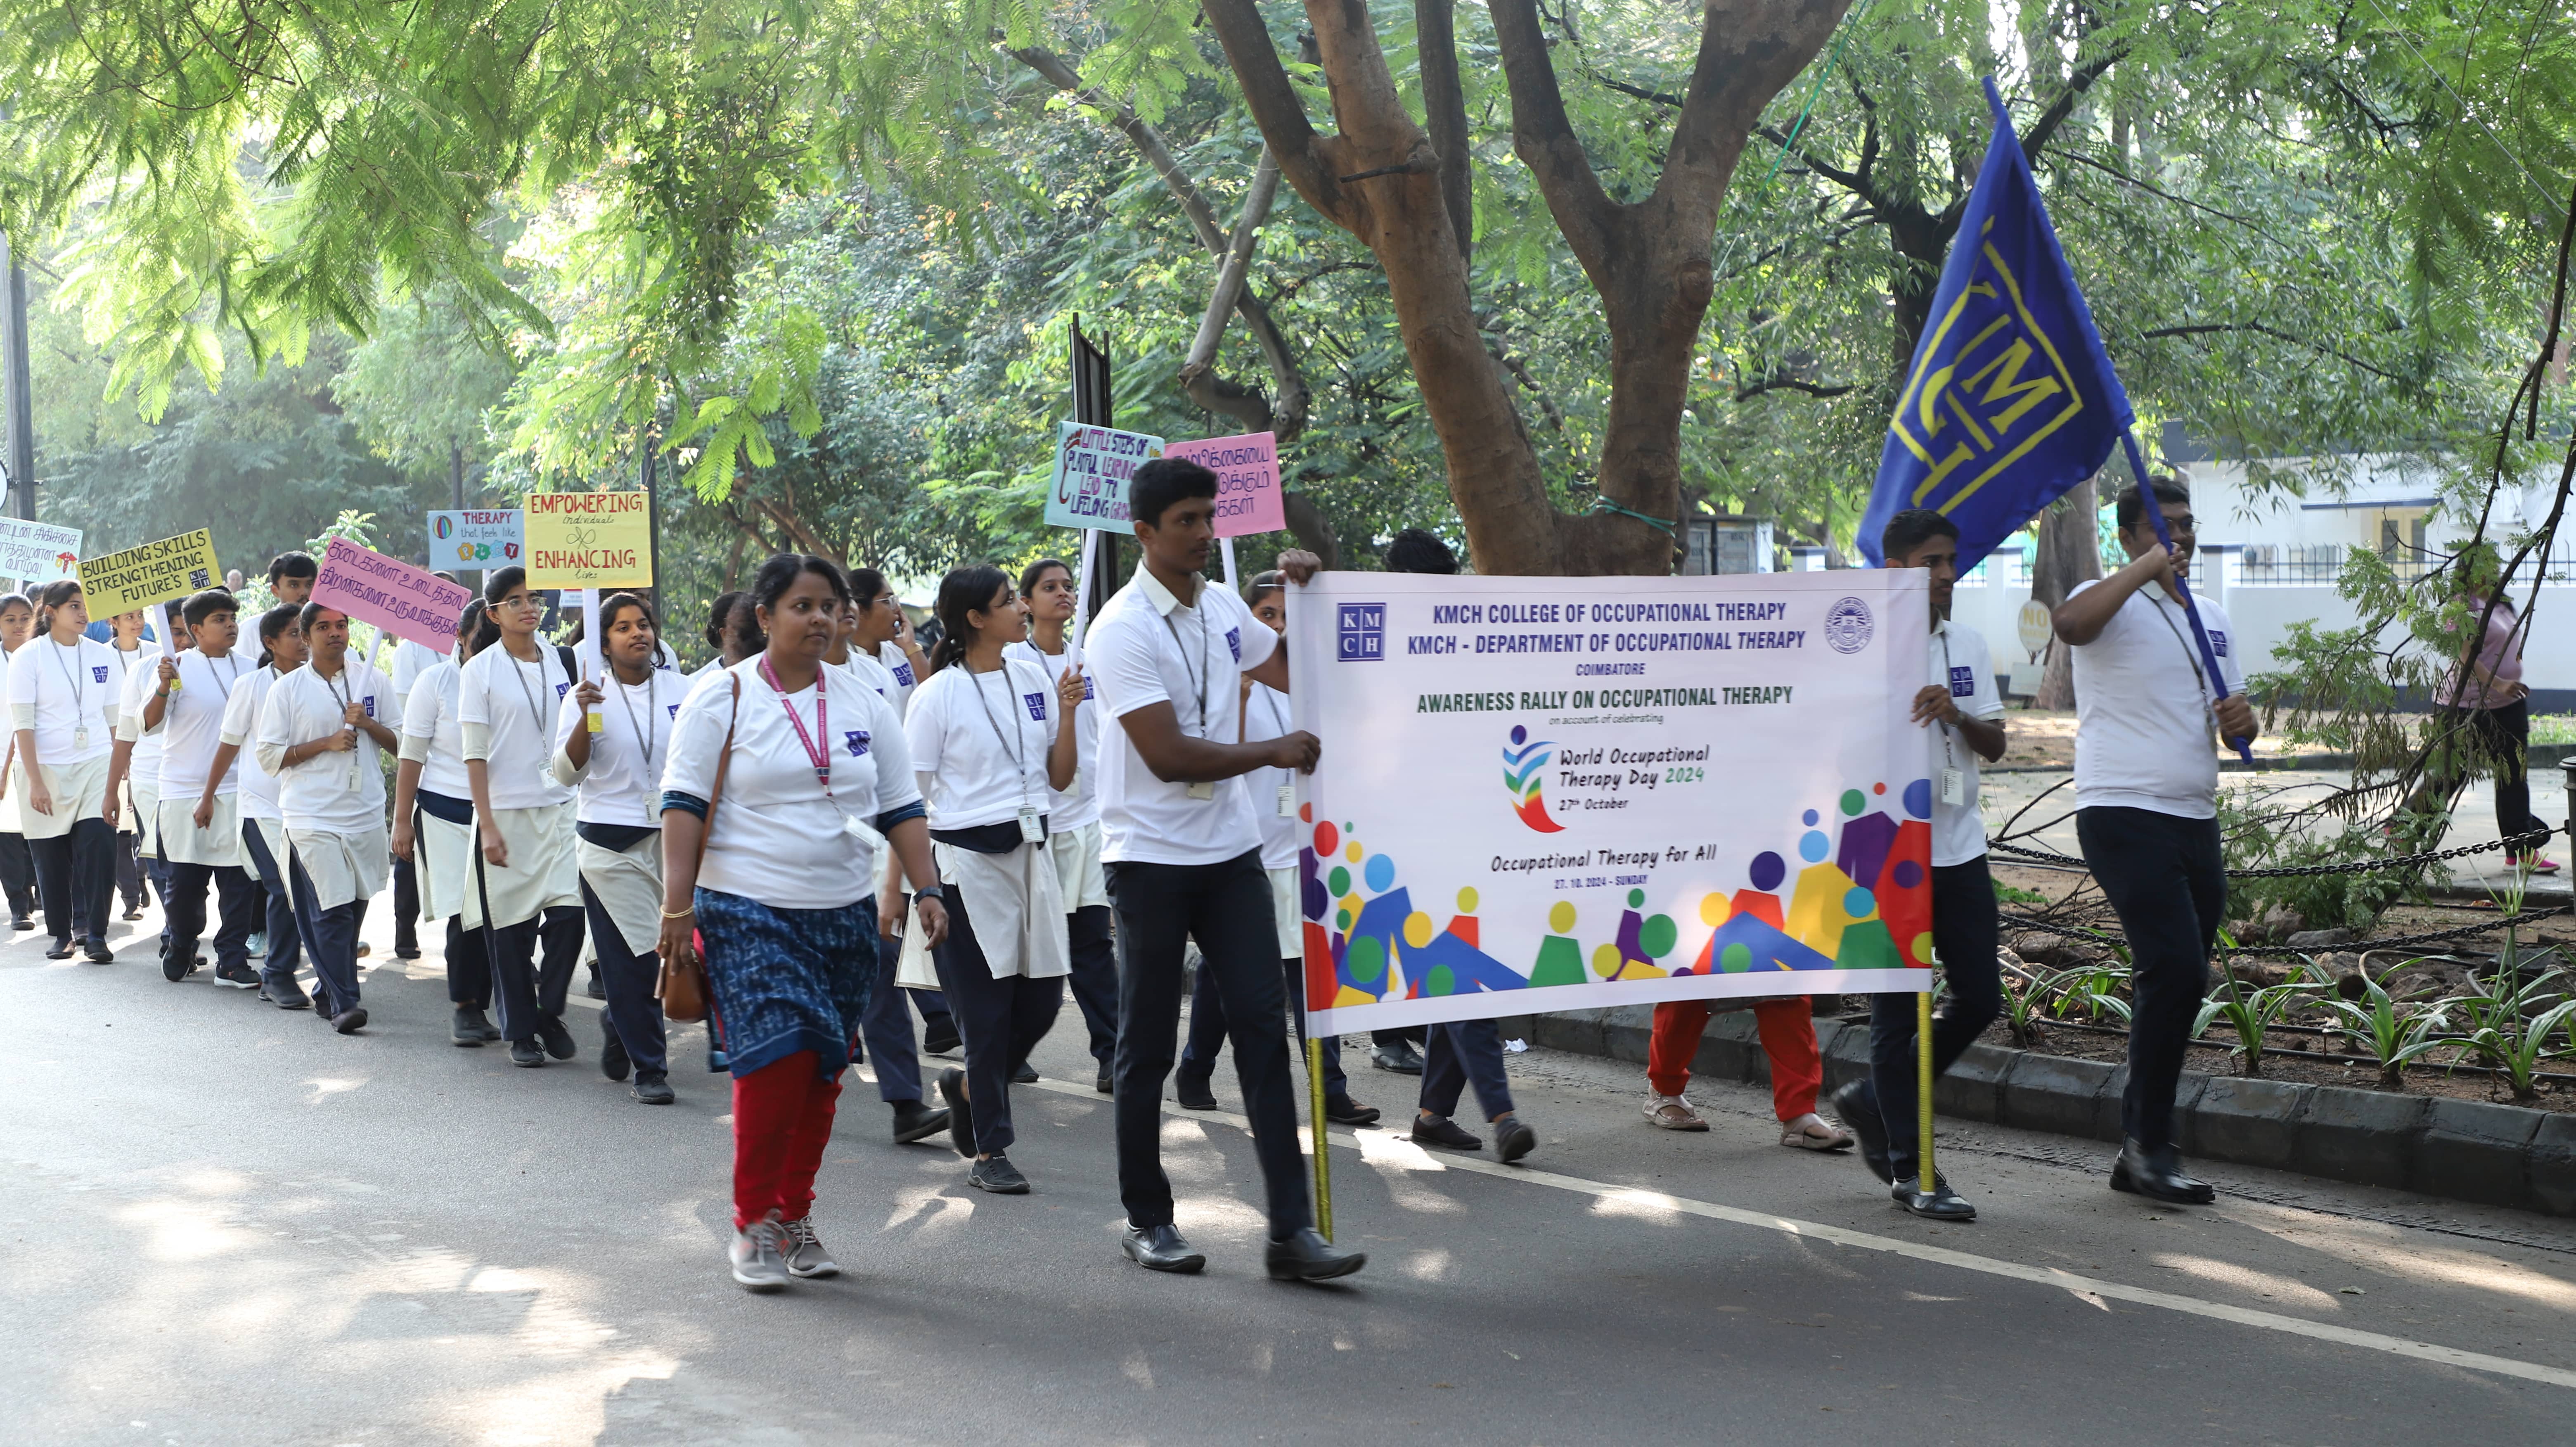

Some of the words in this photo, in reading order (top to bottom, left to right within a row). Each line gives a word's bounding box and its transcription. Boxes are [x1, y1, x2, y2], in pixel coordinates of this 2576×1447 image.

[531, 494, 643, 514] EMPOWERING
[462, 512, 513, 524] THERAPY
[563, 515, 615, 524] individuals
[461, 527, 478, 537] that
[502, 527, 516, 537] like
[81, 545, 152, 579] BUILDING
[153, 531, 206, 559] SKILLS
[328, 541, 401, 581] தடைகளை
[536, 549, 636, 569] ENHANCING
[85, 552, 204, 595] STRENGTHENING
[574, 569, 599, 579] lives
[121, 574, 182, 603] FUTURE'S
[1433, 605, 1482, 624] KMCH
[1489, 604, 1560, 623] COLLEGE
[1565, 603, 1586, 623] OF
[1592, 603, 1711, 622] OCCUPATIONAL
[1716, 602, 1787, 621] THERAPY
[2023, 607, 2048, 628] NO
[1408, 636, 1457, 655] KMCH
[1475, 633, 1584, 653] DEPARTMENT
[1589, 633, 1610, 652] OF
[1616, 632, 1732, 652] OCCUPATIONAL
[1738, 631, 1806, 650] THERAPY
[1576, 663, 1646, 676] COIMBATORE
[1416, 692, 1515, 713] AWARENESS
[1520, 691, 1568, 710] RALLY
[1573, 690, 1595, 709] ON
[1600, 687, 1717, 708] OCCUPATIONAL
[1721, 686, 1793, 705] THERAPY
[1548, 717, 1560, 725] on
[1562, 715, 1599, 725] account
[1601, 714, 1612, 724] of
[1612, 714, 1664, 725] celebrating
[1560, 747, 1604, 766] World
[1610, 744, 1710, 768] Occupational
[1559, 769, 1622, 791] Therapy
[1629, 769, 1659, 789] Day
[1664, 766, 1705, 783] 2024
[1584, 797, 1630, 810] October
[1491, 849, 1591, 875] Occupational
[1598, 848, 1659, 868] Therapy
[1665, 845, 1689, 863] for
[1695, 844, 1717, 861] All
[1585, 877, 1607, 888] 2024
[1615, 874, 1649, 886] SUNDAY
